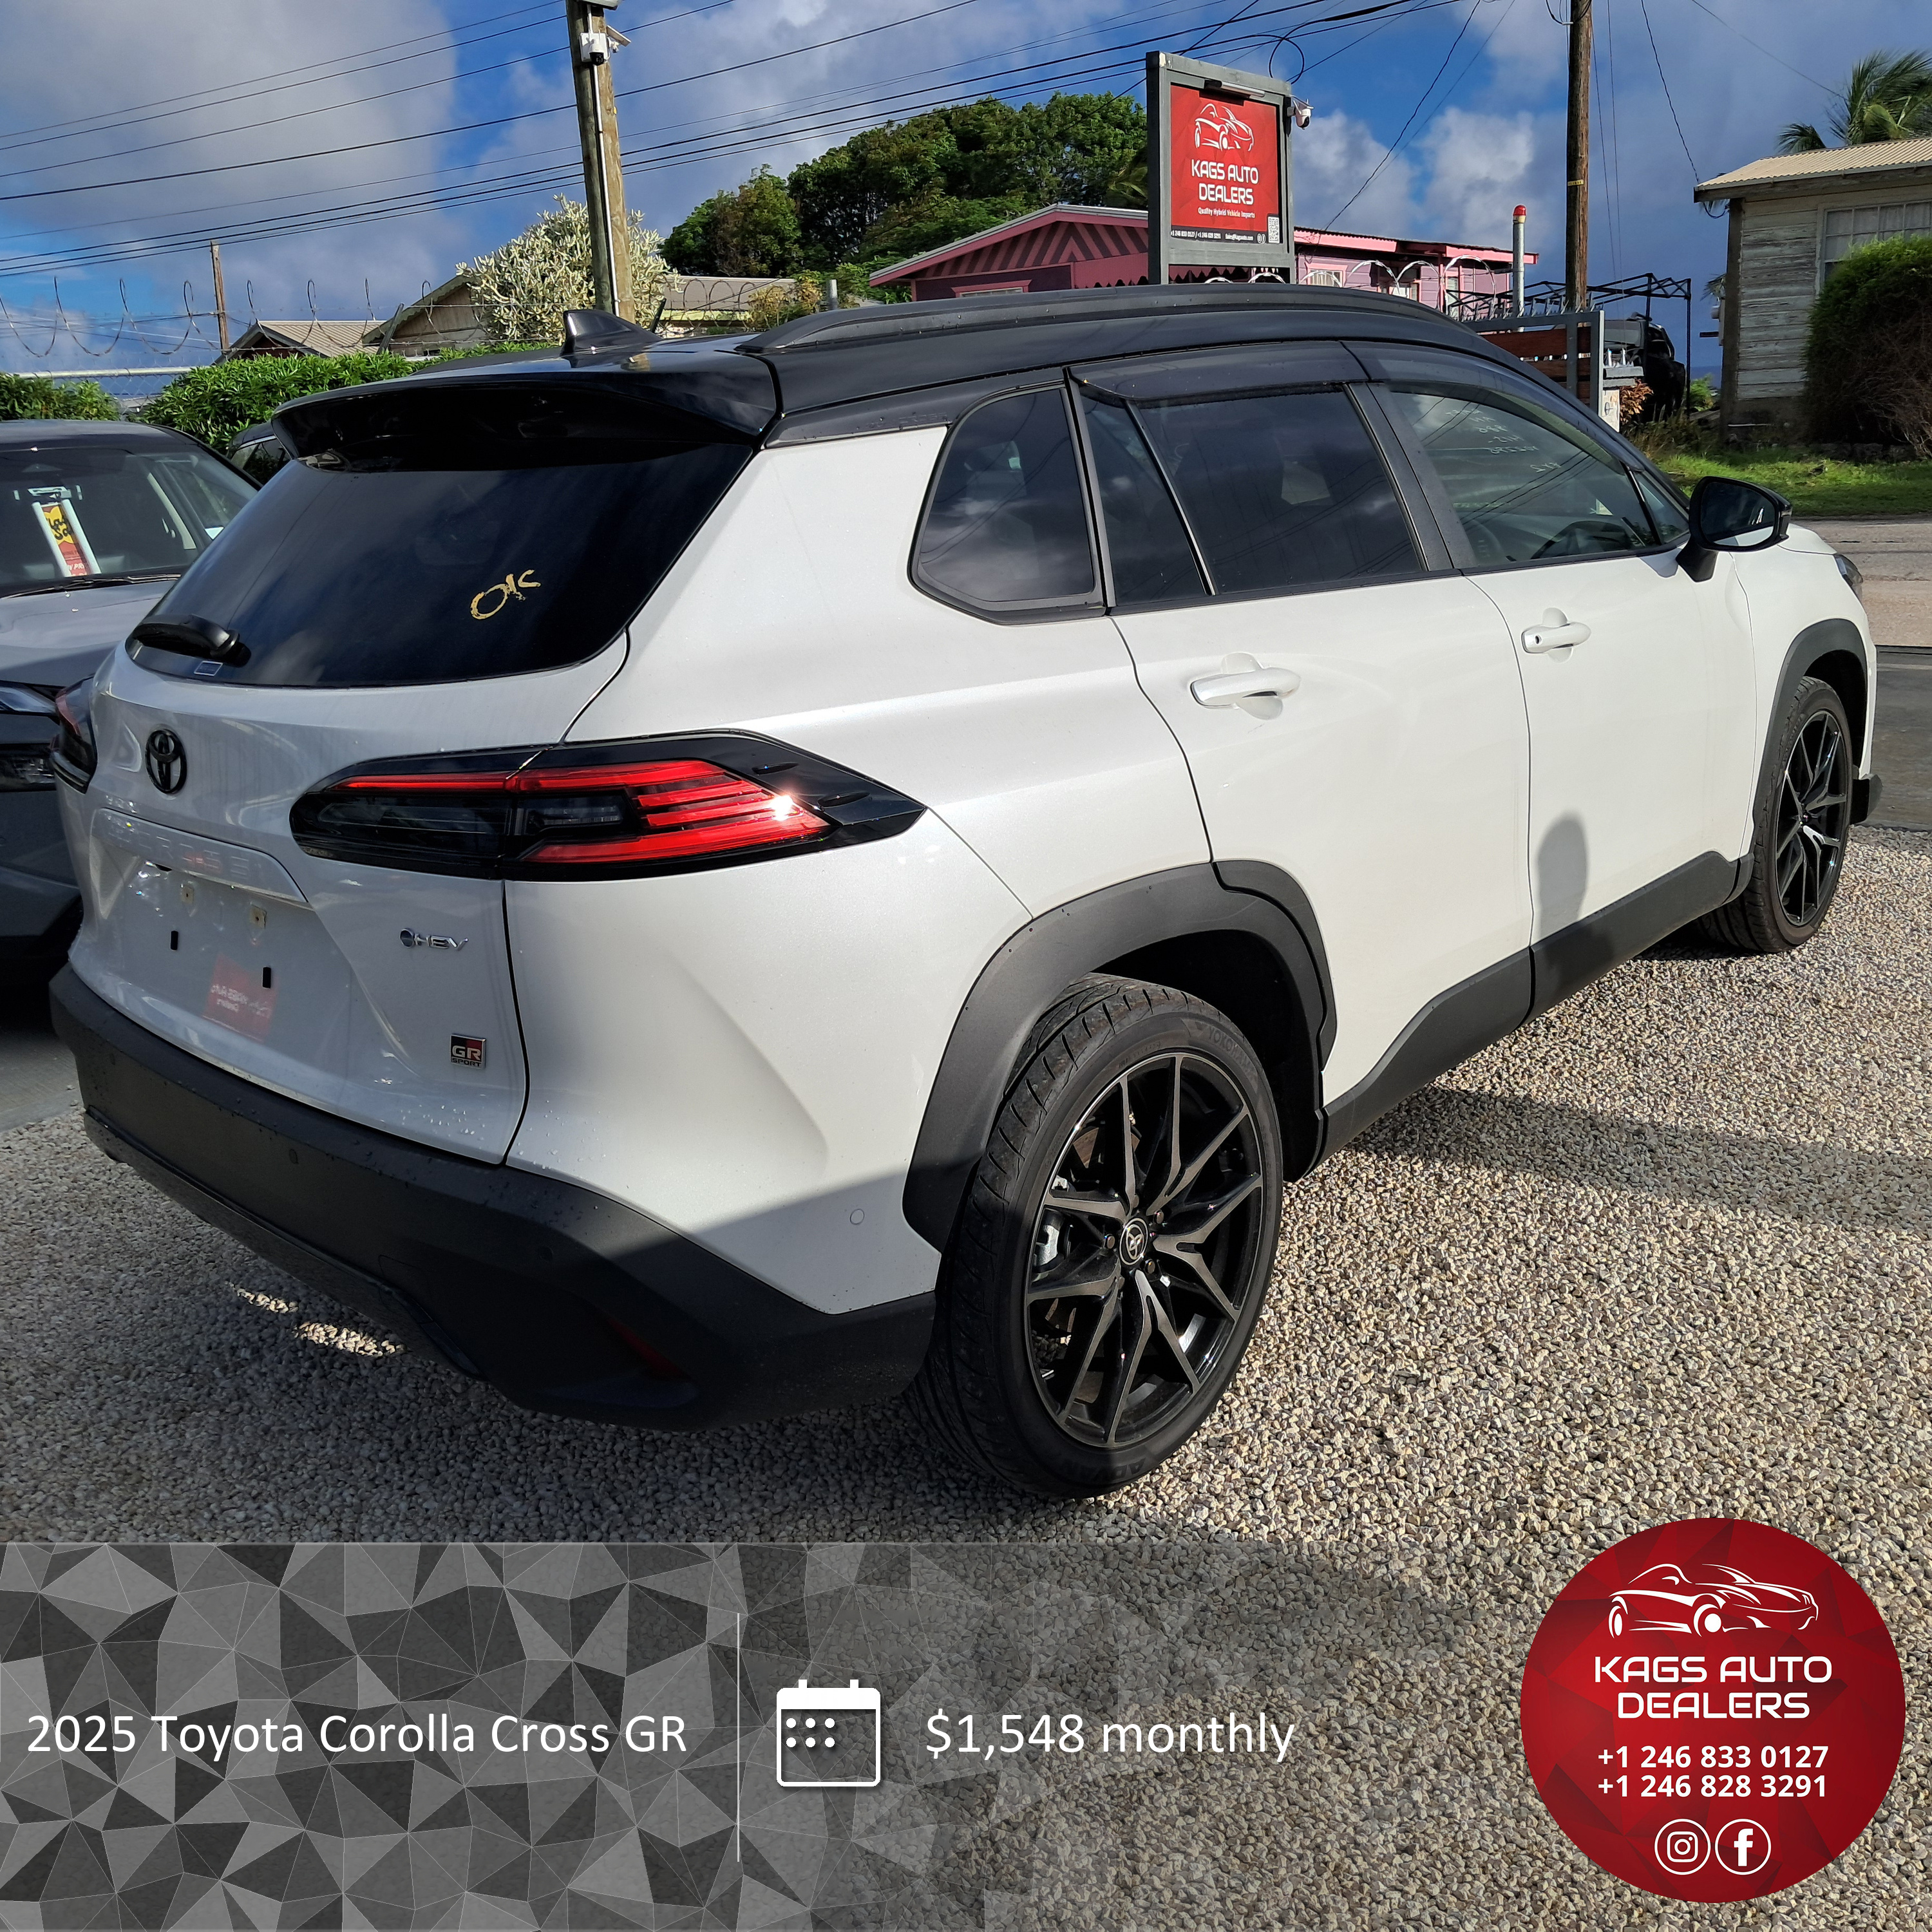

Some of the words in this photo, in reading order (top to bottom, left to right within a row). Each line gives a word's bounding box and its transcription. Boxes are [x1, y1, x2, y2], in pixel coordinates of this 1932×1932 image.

[1191, 159, 1225, 180] KAGS
[1228, 164, 1259, 184] AUTO
[1198, 183, 1254, 205] DEALERS
[1198, 207, 1213, 216] Quality
[1213, 209, 1226, 217] Hybrid
[1227, 209, 1240, 218] Vehicle
[1241, 211, 1255, 219] Imports
[415, 933, 468, 952] HEV
[452, 1045, 481, 1061] GR
[452, 1057, 482, 1068] SPORT
